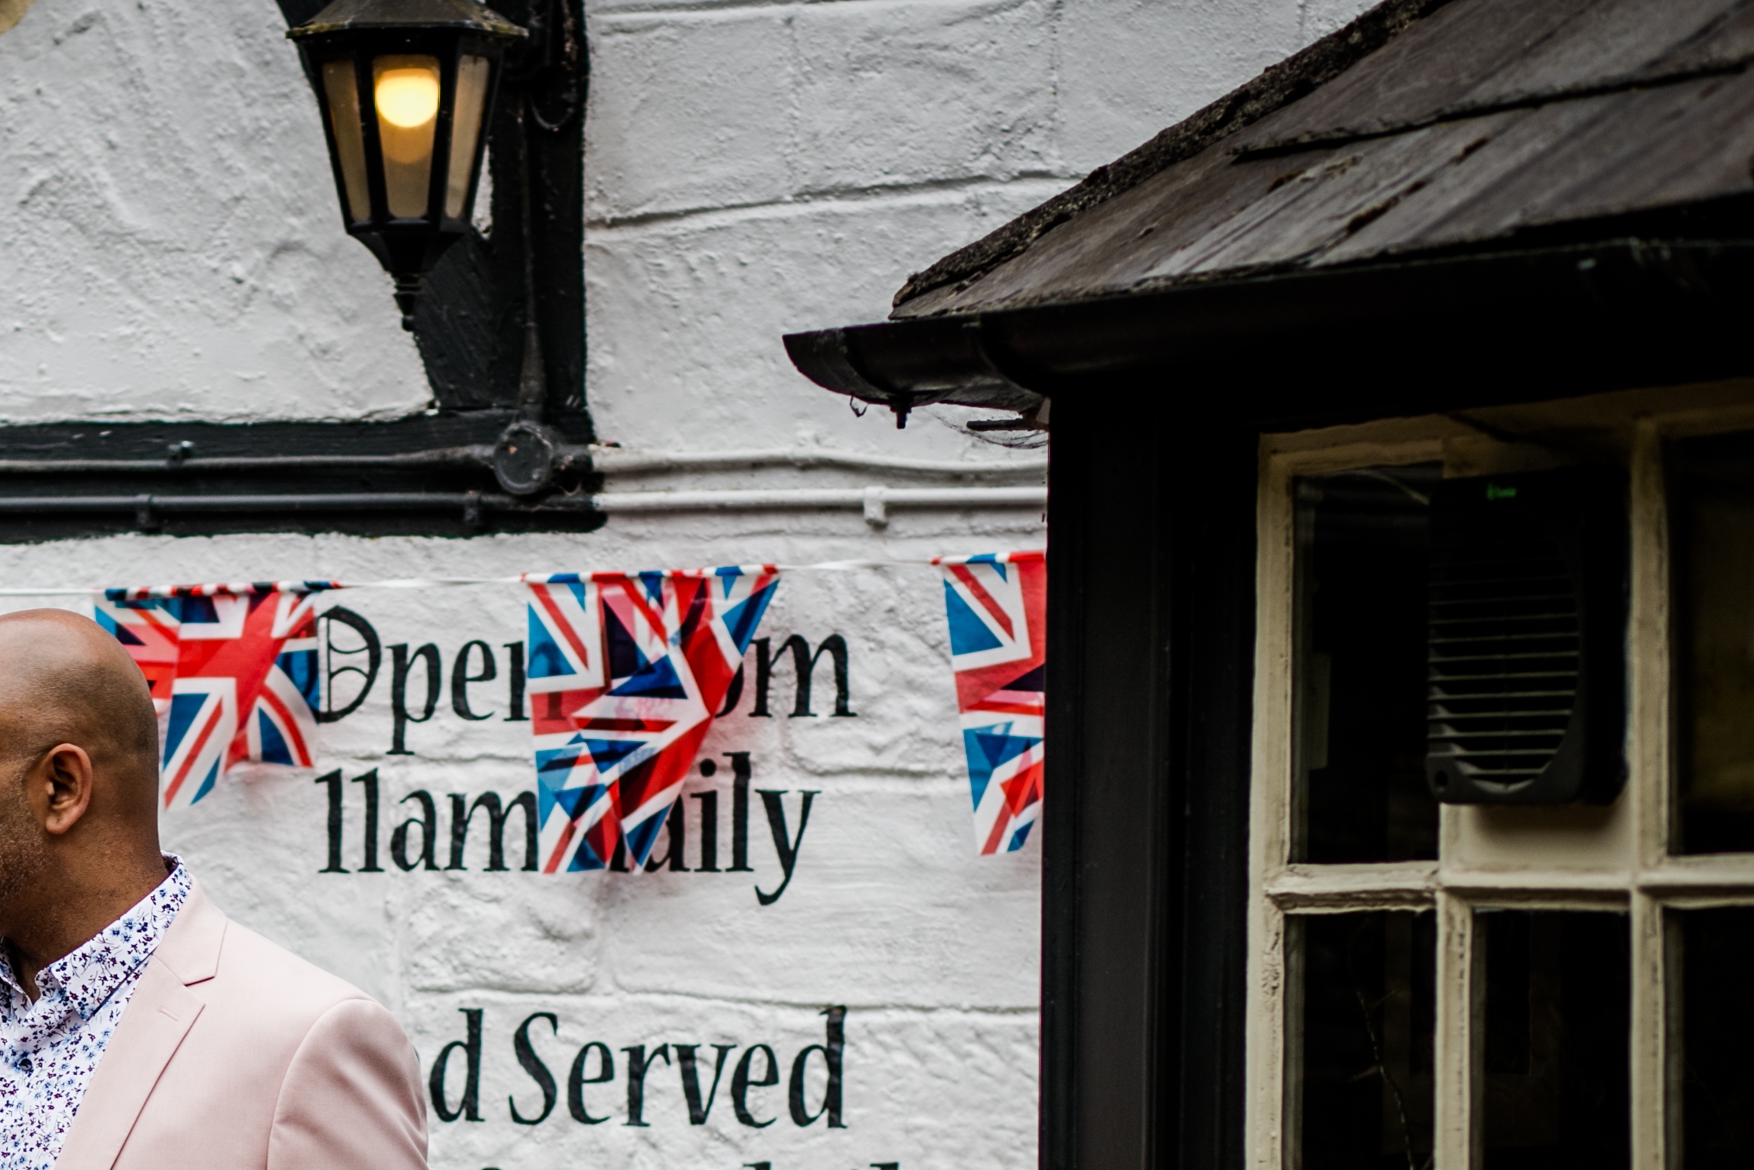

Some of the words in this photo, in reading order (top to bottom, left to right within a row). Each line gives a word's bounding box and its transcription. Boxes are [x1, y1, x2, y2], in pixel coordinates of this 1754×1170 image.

[314, 766, 539, 874] 11am
[584, 751, 823, 907] aily
[508, 1005, 850, 1129] Served
